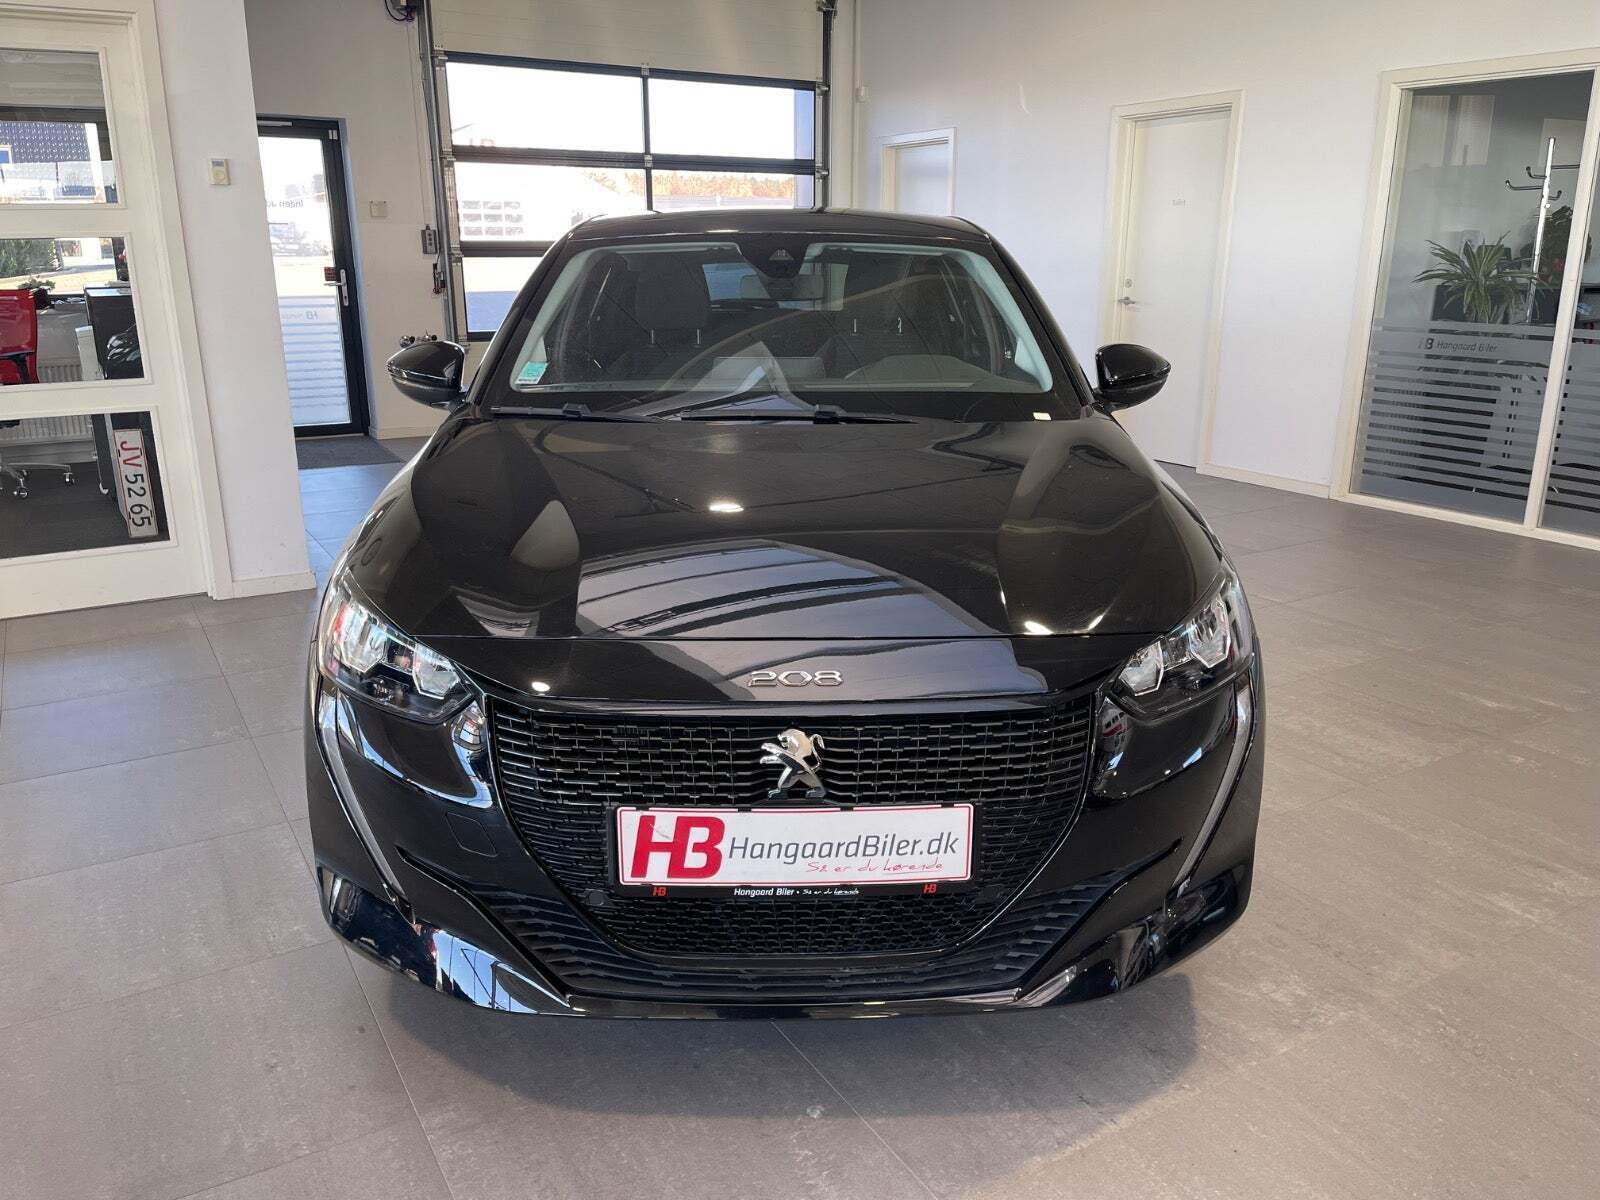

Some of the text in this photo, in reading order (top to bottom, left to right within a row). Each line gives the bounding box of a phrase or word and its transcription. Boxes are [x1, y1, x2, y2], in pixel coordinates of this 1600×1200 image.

[120, 441, 143, 468] JV
[747, 670, 843, 688] 208
[630, 815, 726, 879] HB
[728, 831, 960, 866] HangaardBiler.dk
[652, 886, 667, 897] HB
[734, 888, 774, 898] Hangaard
[776, 888, 795, 896] Biler
[923, 883, 937, 894] HB
